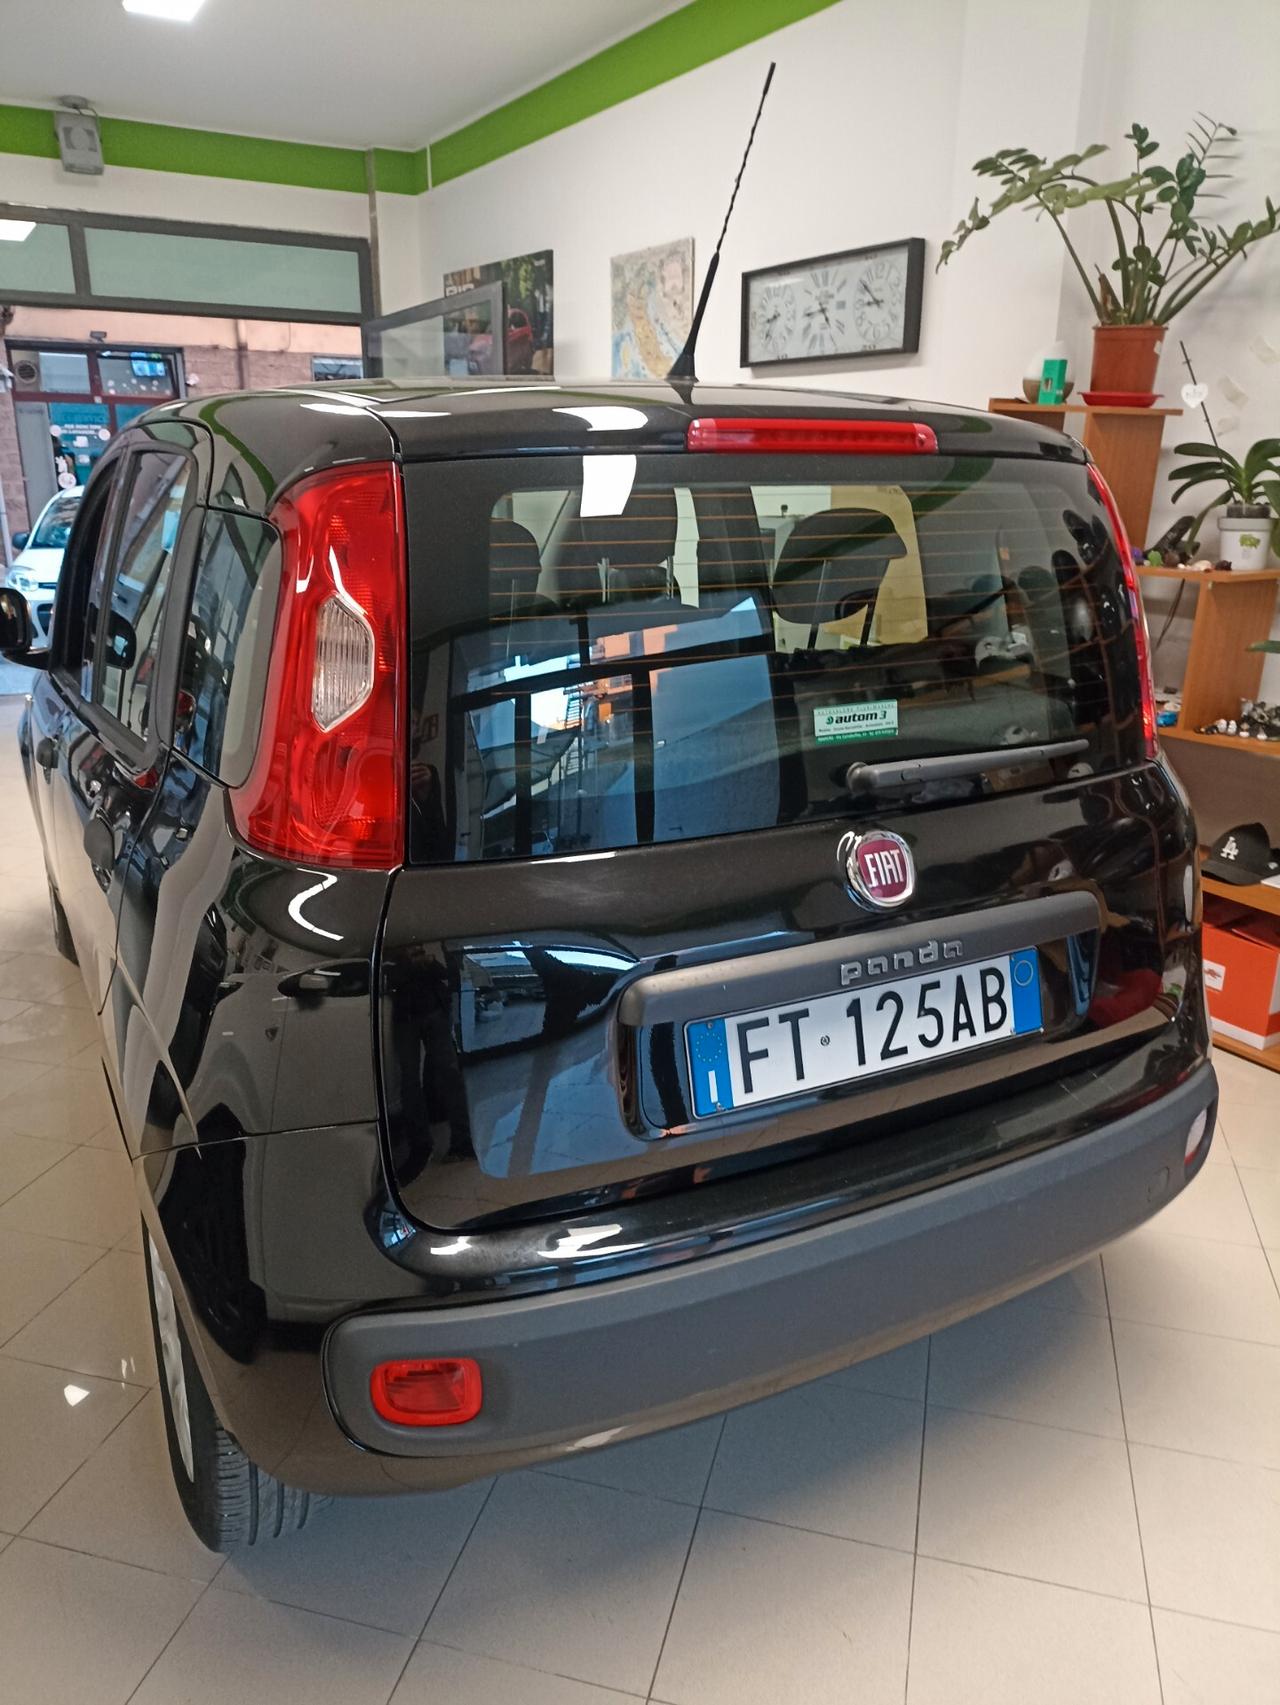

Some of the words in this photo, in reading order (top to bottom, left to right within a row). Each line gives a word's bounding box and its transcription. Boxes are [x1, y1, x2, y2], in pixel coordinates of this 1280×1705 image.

[835, 711, 878, 724] autom
[864, 849, 905, 888] FIAT
[840, 940, 964, 986] panda
[708, 1070, 719, 1104] I
[736, 1008, 810, 1094] FT
[846, 966, 1008, 1067] 125AB
